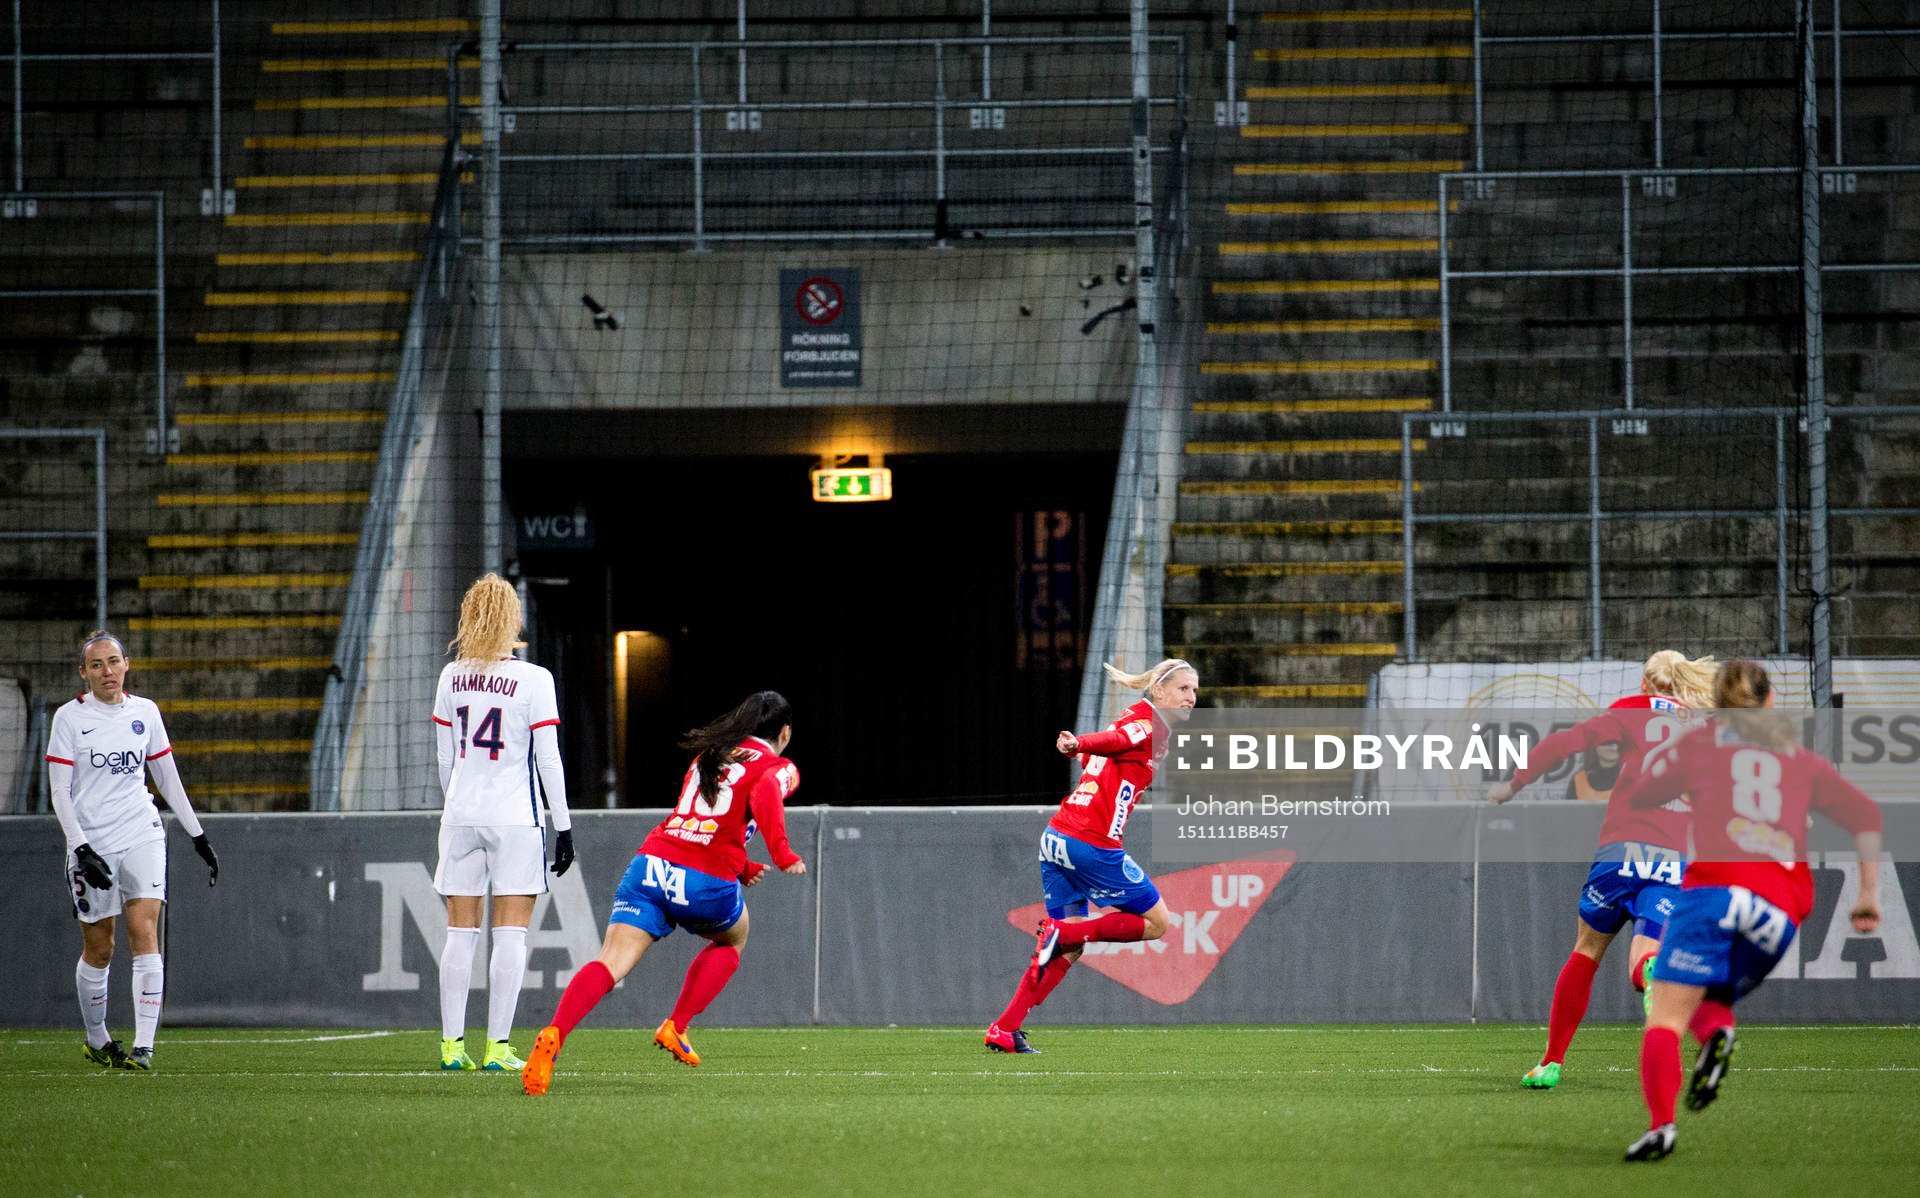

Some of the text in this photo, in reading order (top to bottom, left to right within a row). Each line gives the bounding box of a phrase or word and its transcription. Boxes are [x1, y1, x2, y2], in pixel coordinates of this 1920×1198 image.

[525, 516, 571, 538] WC
[452, 674, 518, 698] HAMRAOUI
[456, 705, 505, 761] 14
[1731, 749, 1782, 824] 8
[642, 853, 690, 906] NA
[1618, 842, 1682, 886] NA
[1211, 874, 1265, 908] UP
[1717, 884, 1798, 954] NA
